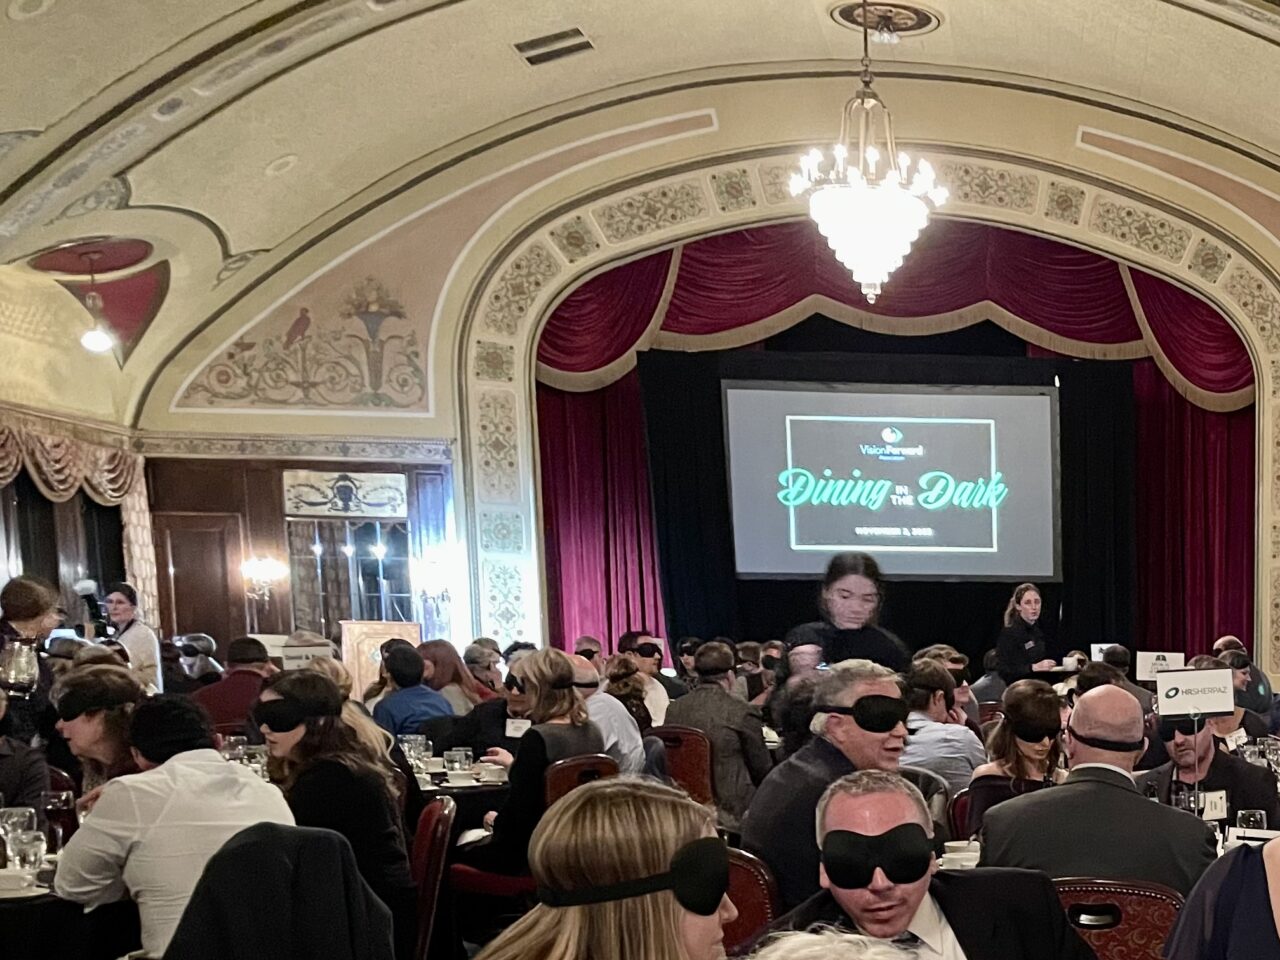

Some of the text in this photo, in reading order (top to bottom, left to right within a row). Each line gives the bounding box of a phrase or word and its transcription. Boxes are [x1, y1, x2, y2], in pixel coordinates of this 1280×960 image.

[777, 467, 1009, 511] Dining IN THE Dark
